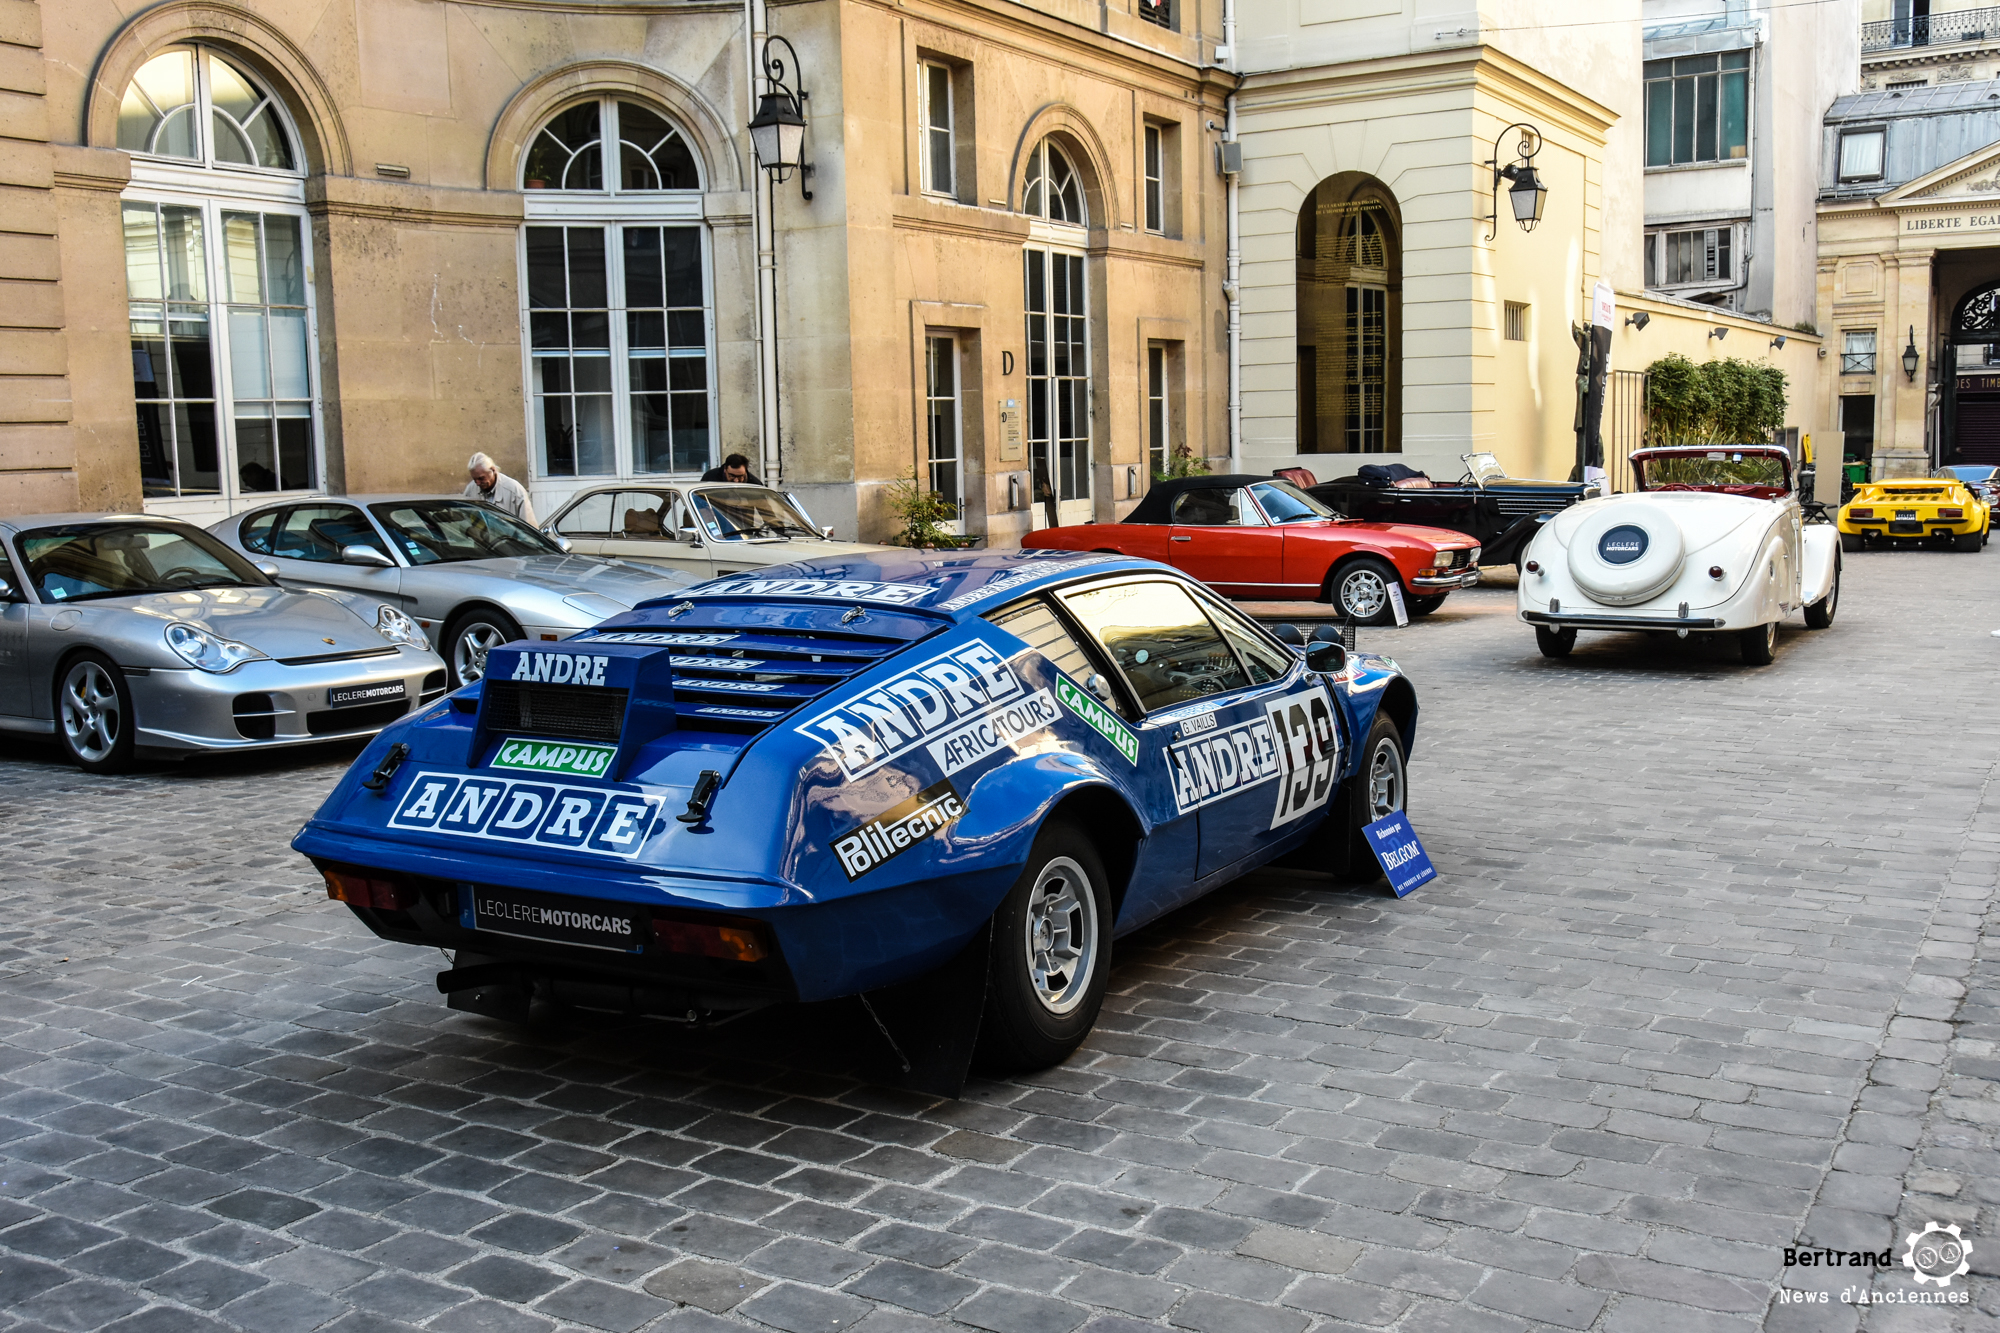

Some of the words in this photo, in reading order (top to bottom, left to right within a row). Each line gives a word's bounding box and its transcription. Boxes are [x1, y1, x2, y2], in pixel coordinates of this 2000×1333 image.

[1907, 217, 1961, 231] LIBERTE
[1001, 350, 1015, 376] D
[696, 580, 922, 602] ANDRE
[586, 633, 731, 645] ANDRE
[511, 652, 608, 686] ANDRE
[670, 655, 757, 669] NDRE
[816, 645, 1017, 771] ANDRE
[1061, 682, 1138, 759] CAMPUS
[942, 695, 1056, 770] AFRICATOURS
[1182, 722, 1193, 734] G.
[1191, 714, 1216, 732] VAILLS
[501, 743, 609, 772] CAMPUS
[1177, 724, 1278, 805] ANDRE
[402, 781, 648, 844] ANDRE
[478, 899, 632, 935] LECLEREMOTORCARS
